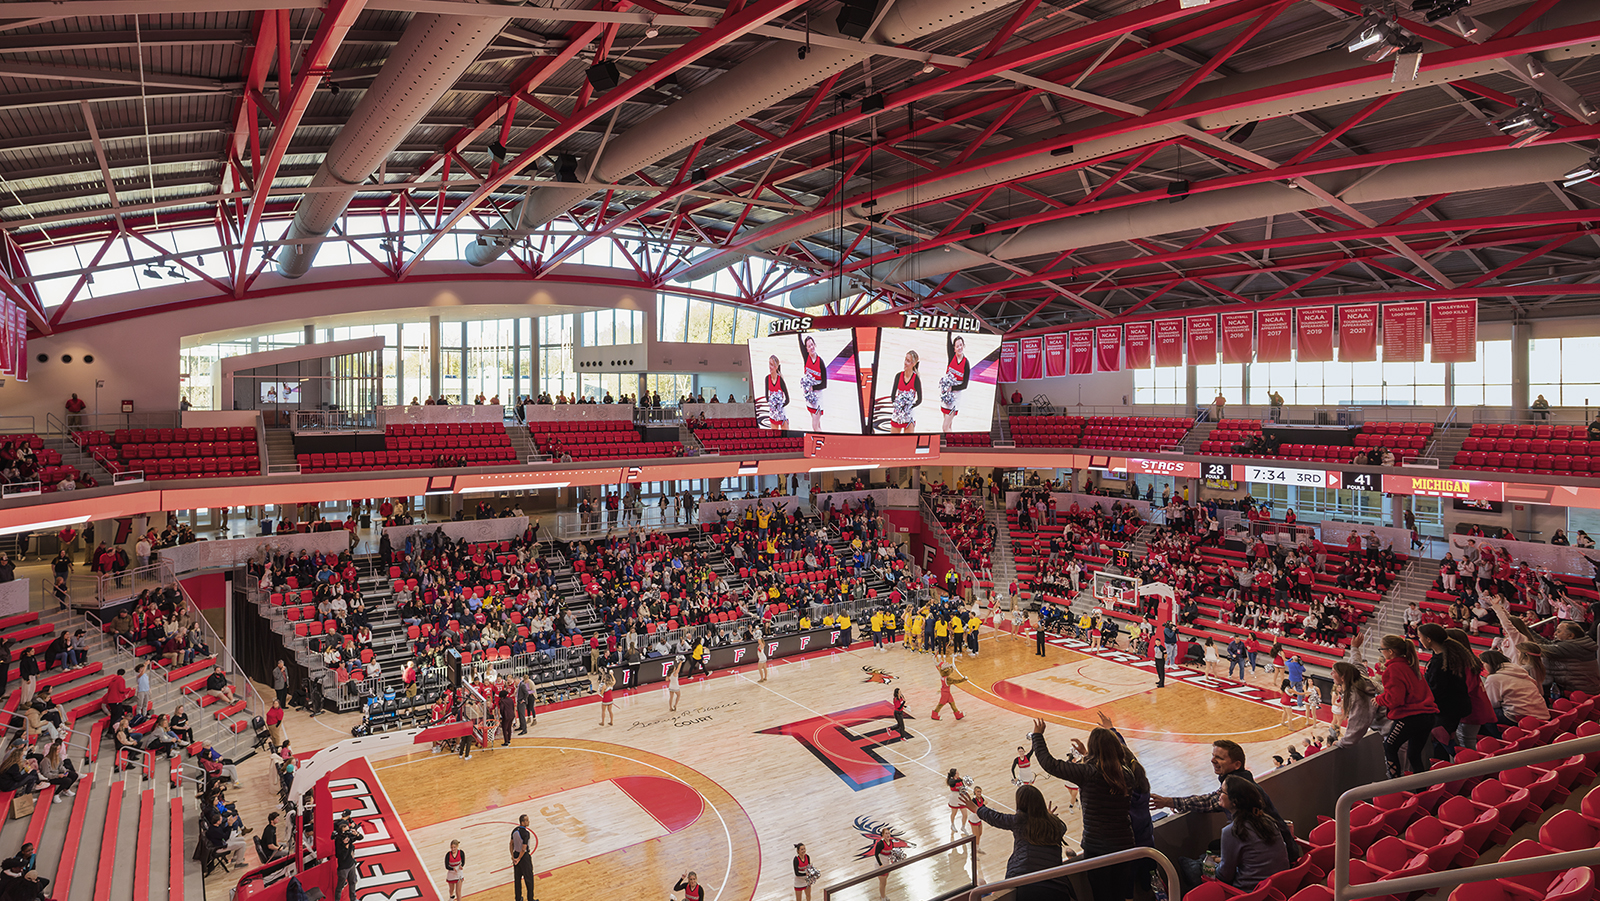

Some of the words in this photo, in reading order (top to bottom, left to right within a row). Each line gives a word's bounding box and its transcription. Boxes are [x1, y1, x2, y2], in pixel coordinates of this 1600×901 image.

[771, 317, 812, 333] STAGS
[905, 314, 981, 331] FAIRFIELD
[1141, 460, 1185, 471] STAGS
[1209, 464, 1224, 475] 28
[1253, 469, 1286, 481] 7:34
[1296, 473, 1322, 483] 3RD
[1354, 474, 1371, 485] 41
[1412, 478, 1470, 493] MICHIGAN
[922, 542, 937, 571] F
[1117, 556, 1127, 567] 30
[800, 636, 810, 650] F
[830, 630, 840, 644] F
[734, 648, 746, 663] F
[768, 642, 779, 656] F
[662, 661, 674, 677] F
[674, 715, 713, 728] COURT
[752, 699, 916, 792] F
